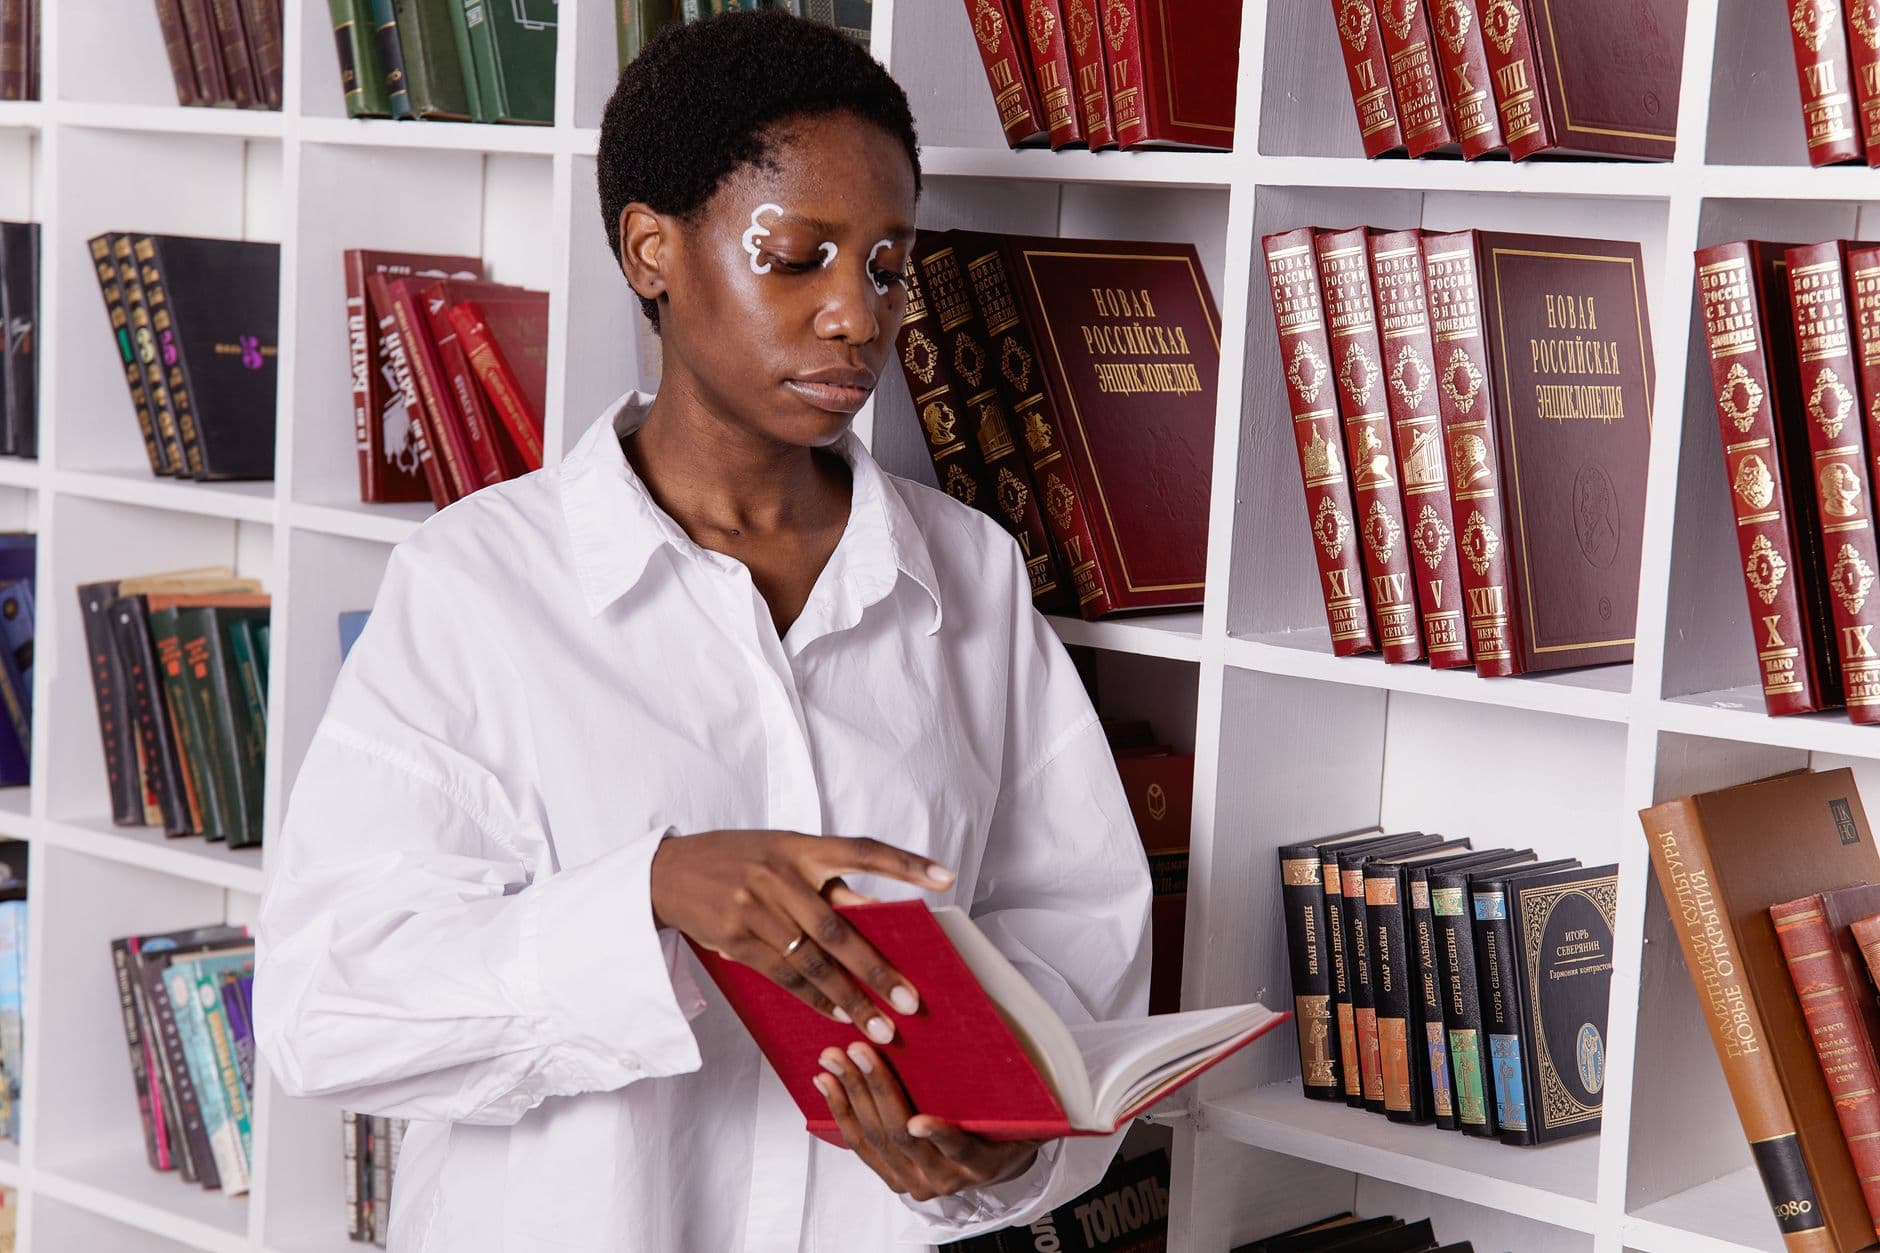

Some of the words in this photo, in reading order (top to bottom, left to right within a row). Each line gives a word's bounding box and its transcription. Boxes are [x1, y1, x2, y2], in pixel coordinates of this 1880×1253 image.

[990, 58, 1014, 90] VII
[1112, 58, 1128, 91] IV
[1355, 58, 1377, 91] VI
[1453, 62, 1474, 96] X
[1497, 59, 1529, 96] VIII
[1804, 59, 1837, 97] VII
[1270, 254, 1311, 273] НОВАЯ
[1272, 266, 1313, 287] РОССИЙ
[1323, 255, 1364, 273] НОВАЯ
[1325, 267, 1366, 288] РОССИЙ
[1377, 256, 1418, 274] НОВАЯ
[1378, 269, 1420, 288] РОССИЙ
[1428, 258, 1471, 277] НОВАЯ
[1275, 282, 1315, 300] СКАЯ
[1328, 283, 1368, 300] СКАЯ
[1381, 284, 1421, 302] СКАЯ
[1430, 271, 1473, 291] РОССИЙ
[1702, 268, 1747, 290] НОВАЯ
[1794, 272, 1839, 292] НОВАЯ
[1091, 288, 1156, 317] НОВАЯ
[1276, 295, 1318, 313] ЭНЦИК
[1329, 297, 1370, 314] ЭНЦИК
[1382, 299, 1424, 316] ЭНЦИК
[1432, 287, 1474, 305] СКАЯ
[1433, 301, 1475, 319] ЭНЦИК
[1545, 294, 1597, 330] НОВАЯ
[1080, 322, 1190, 355] РОССИЙСКАЯ
[1530, 335, 1620, 375] РОССИЙСКАЯ
[1094, 363, 1202, 397] ЭНЦИКЛОПЕДИЯ
[1536, 384, 1625, 424] ЭНЦИКЛОПЕДИЯ
[1327, 522, 1333, 534] 2
[1378, 527, 1383, 538] 2
[1427, 530, 1434, 543] 2
[1064, 535, 1083, 567] IV
[1475, 538, 1480, 550] 1
[1326, 568, 1352, 599] XI
[1761, 563, 1769, 577] 2
[1847, 572, 1854, 586] 1
[1372, 572, 1406, 605] XIV
[1429, 579, 1443, 609] V
[1468, 585, 1506, 618] XIII
[1762, 614, 1785, 648] X
[1842, 624, 1877, 659] IX
[1659, 831, 1701, 926] КУЛЬТУРЫ
[1304, 905, 1316, 942] БУНИН
[1330, 905, 1342, 952] ШЕКСПИР
[1354, 918, 1366, 957] РОНСАР
[1565, 929, 1589, 942] ИГОРЬ
[1690, 869, 1734, 977] ОТКРЫТИЯ
[1378, 926, 1389, 961] ХАЙЯМ
[1419, 921, 1433, 968] ДАВЫДОВ
[1446, 928, 1459, 973] ЕСЕНИН
[1556, 940, 1600, 957] СЕВЕРЯНИН
[1308, 945, 1318, 975] ИВАН
[1358, 960, 1369, 985] ПЬЕР
[1487, 931, 1500, 989] СЕВЕРЯНИН
[1382, 964, 1392, 992] ОМАР
[1424, 972, 1436, 1007] ДЕНИС
[1450, 975, 1463, 1015] СЕРГЕЙ
[1494, 990, 1503, 1023] ИГОРЬ
[1691, 934, 1742, 1058] ПАМЯТНИКИ
[1725, 985, 1760, 1055] НОВЫЕ
[1074, 1175, 1169, 1249] ТОПОЛЬ
[1775, 1200, 1812, 1221] 1980
